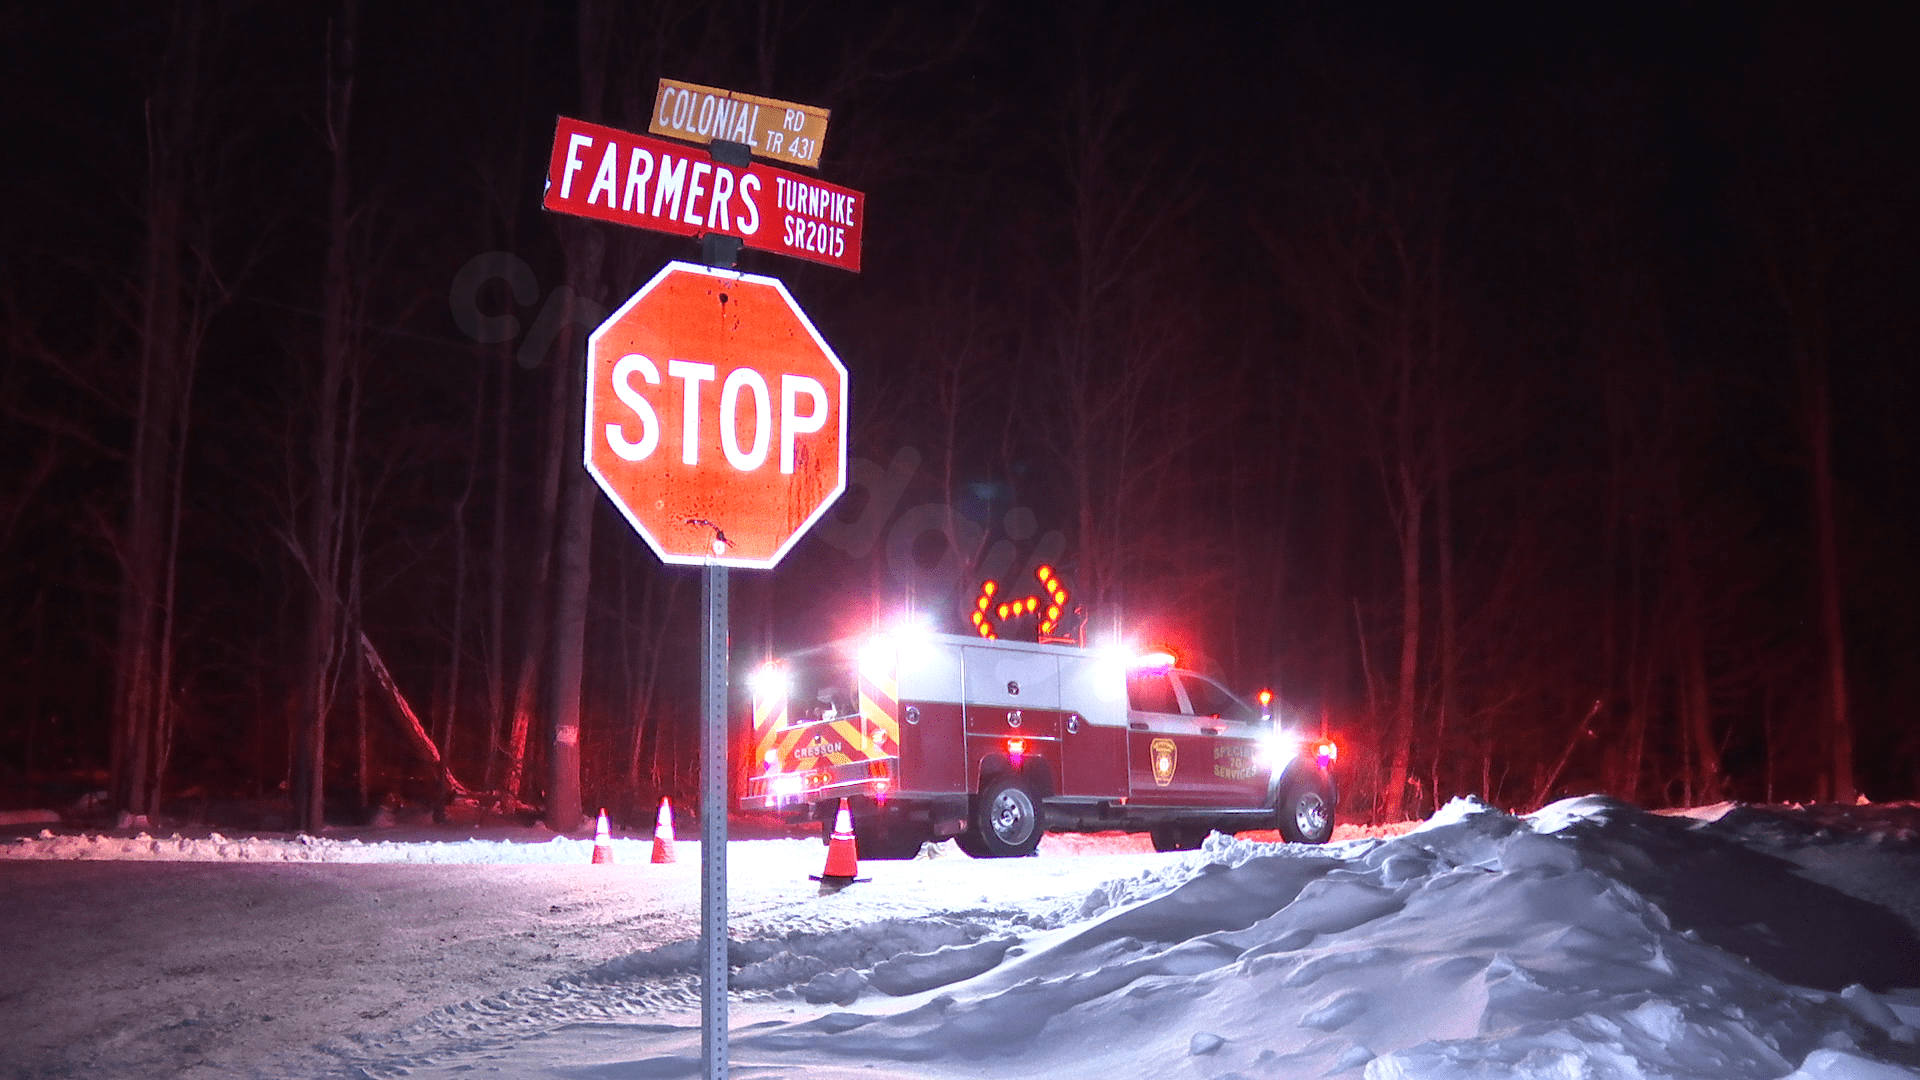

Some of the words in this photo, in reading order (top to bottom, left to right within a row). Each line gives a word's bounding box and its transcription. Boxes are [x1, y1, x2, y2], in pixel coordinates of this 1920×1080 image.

[659, 87, 760, 146] COLONIAL
[783, 108, 805, 132] RD
[766, 130, 784, 153] TR
[788, 136, 814, 160] 431
[559, 133, 761, 235] FARMERS
[776, 177, 856, 227] TURNPIKE
[783, 215, 845, 258] SR2015
[605, 353, 829, 474] STOP
[794, 742, 842, 758] CRESSON
[1213, 764, 1257, 780] SERVICES
